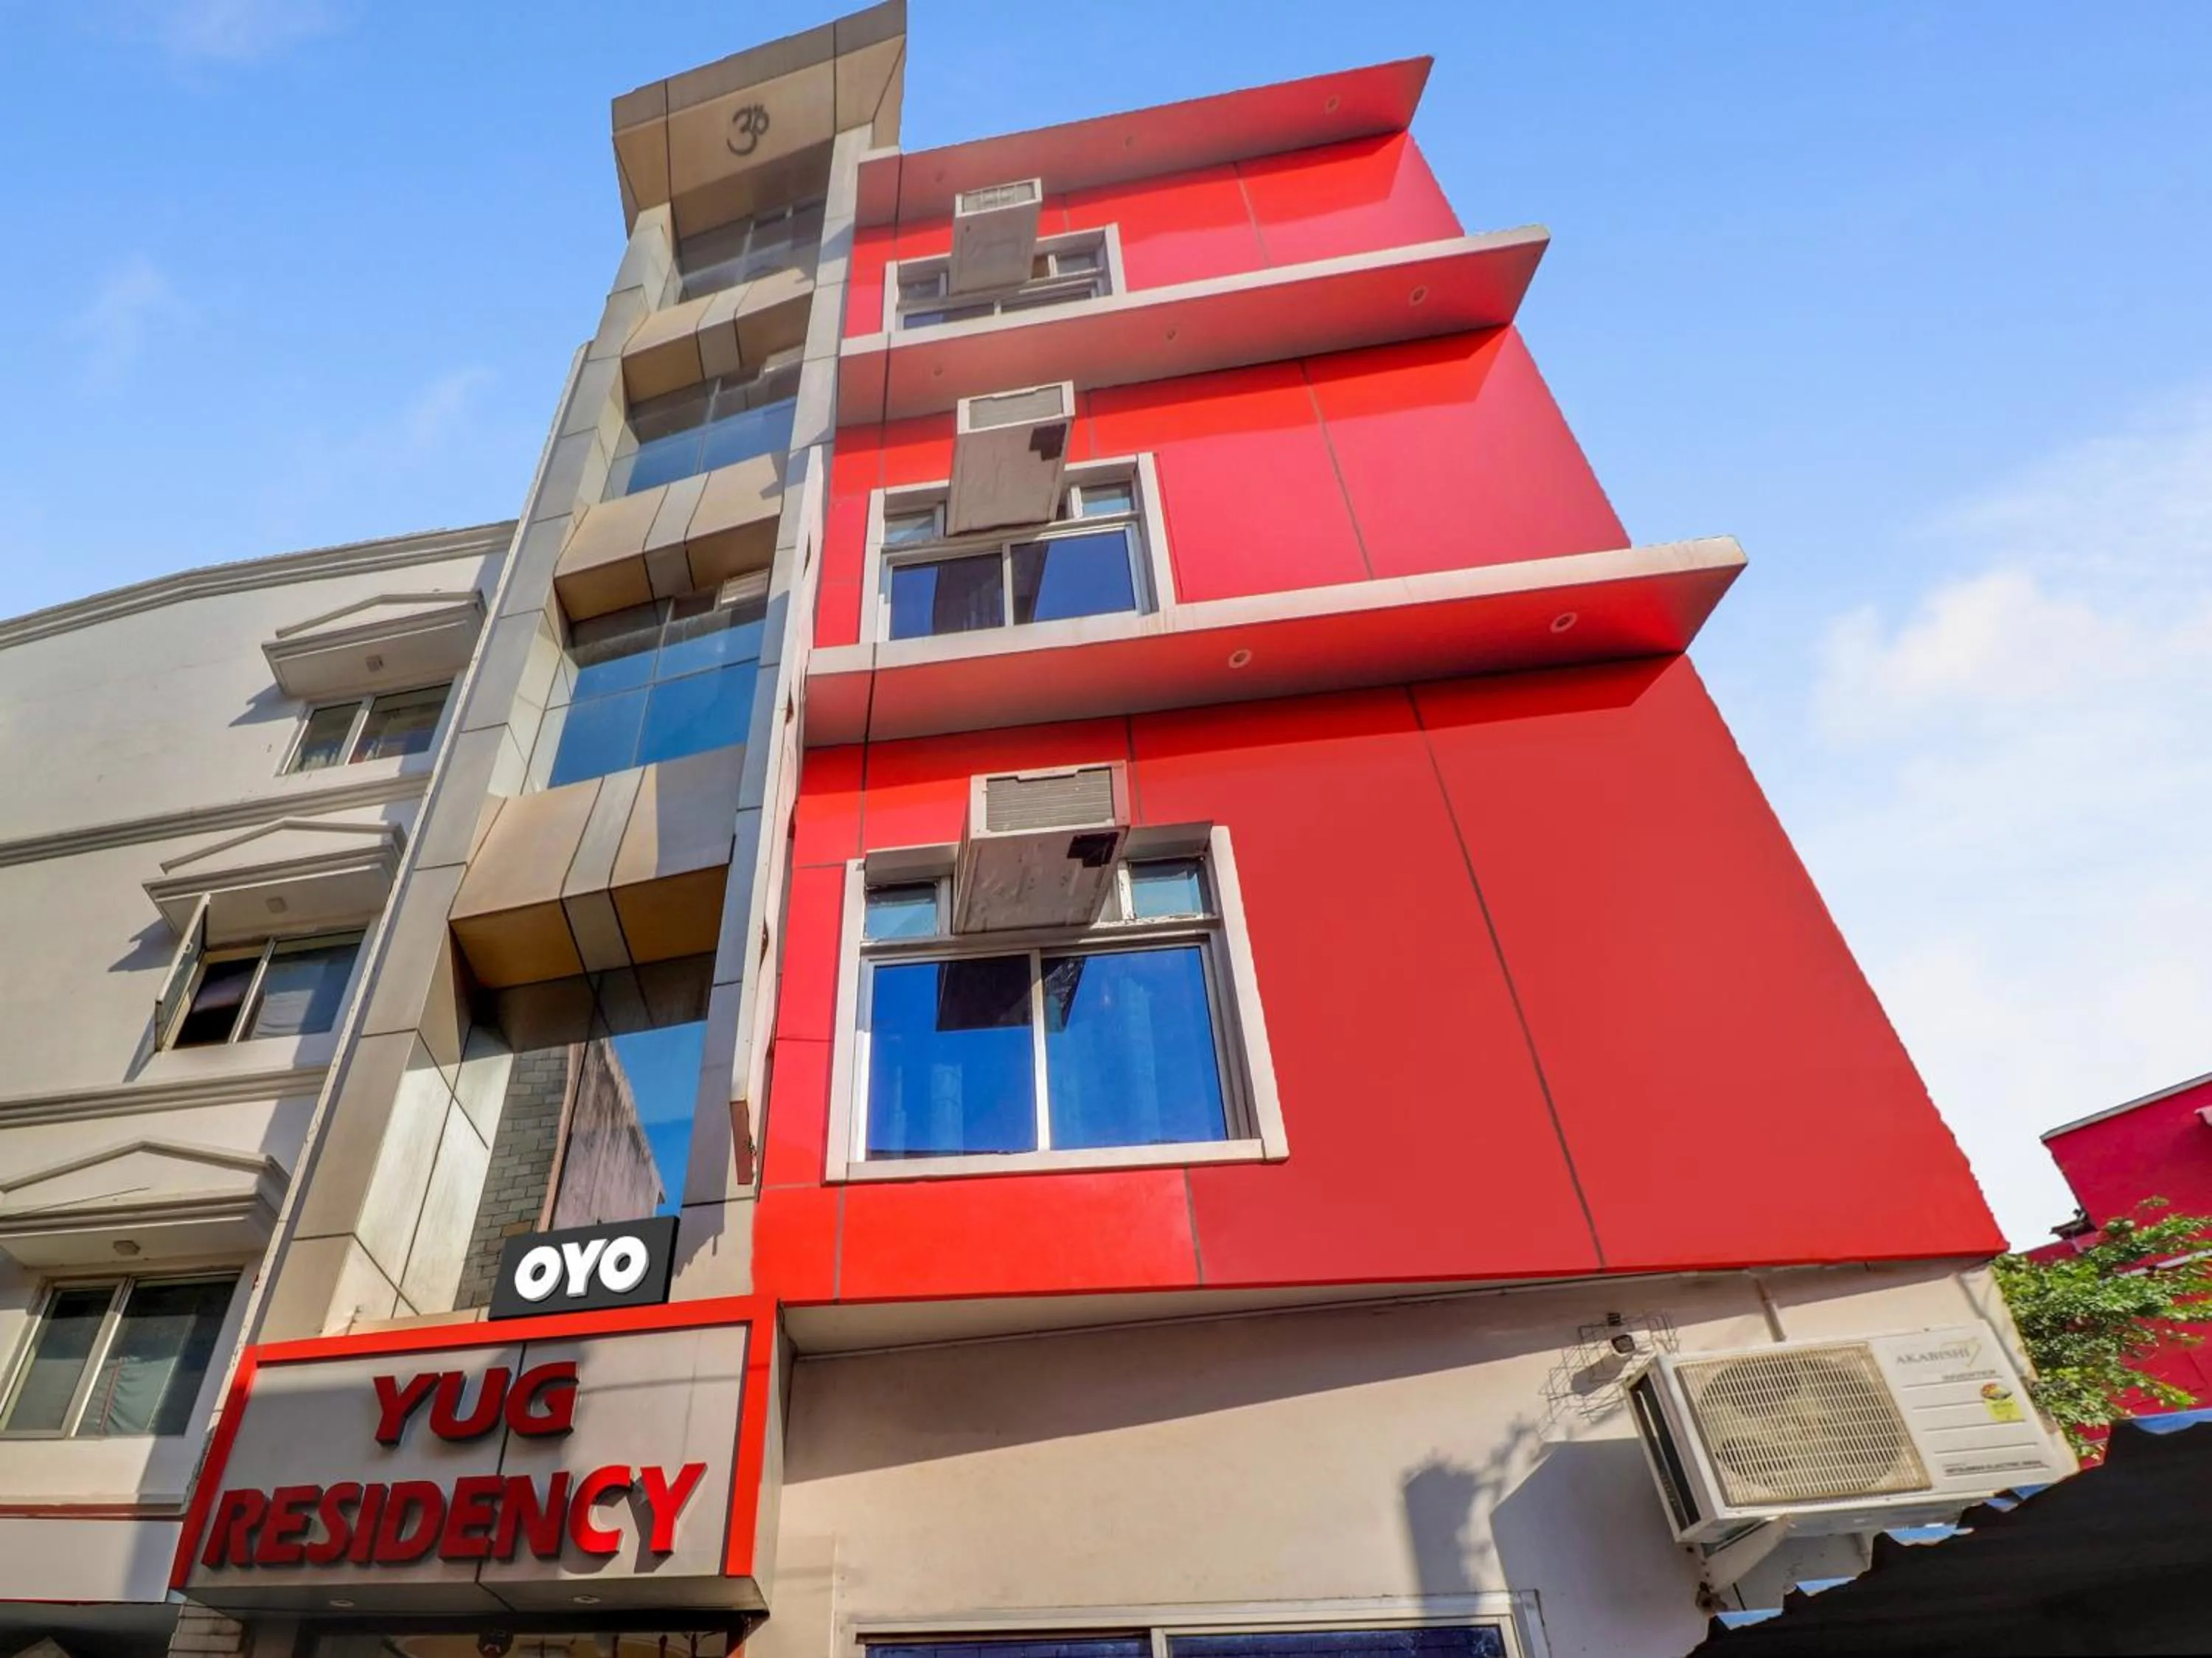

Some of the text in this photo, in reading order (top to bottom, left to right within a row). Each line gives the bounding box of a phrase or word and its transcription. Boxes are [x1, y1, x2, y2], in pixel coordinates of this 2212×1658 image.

[515, 1236, 650, 1302] OYO
[373, 1362, 580, 1446] YUG
[202, 1463, 708, 1568] RESIDENCY
